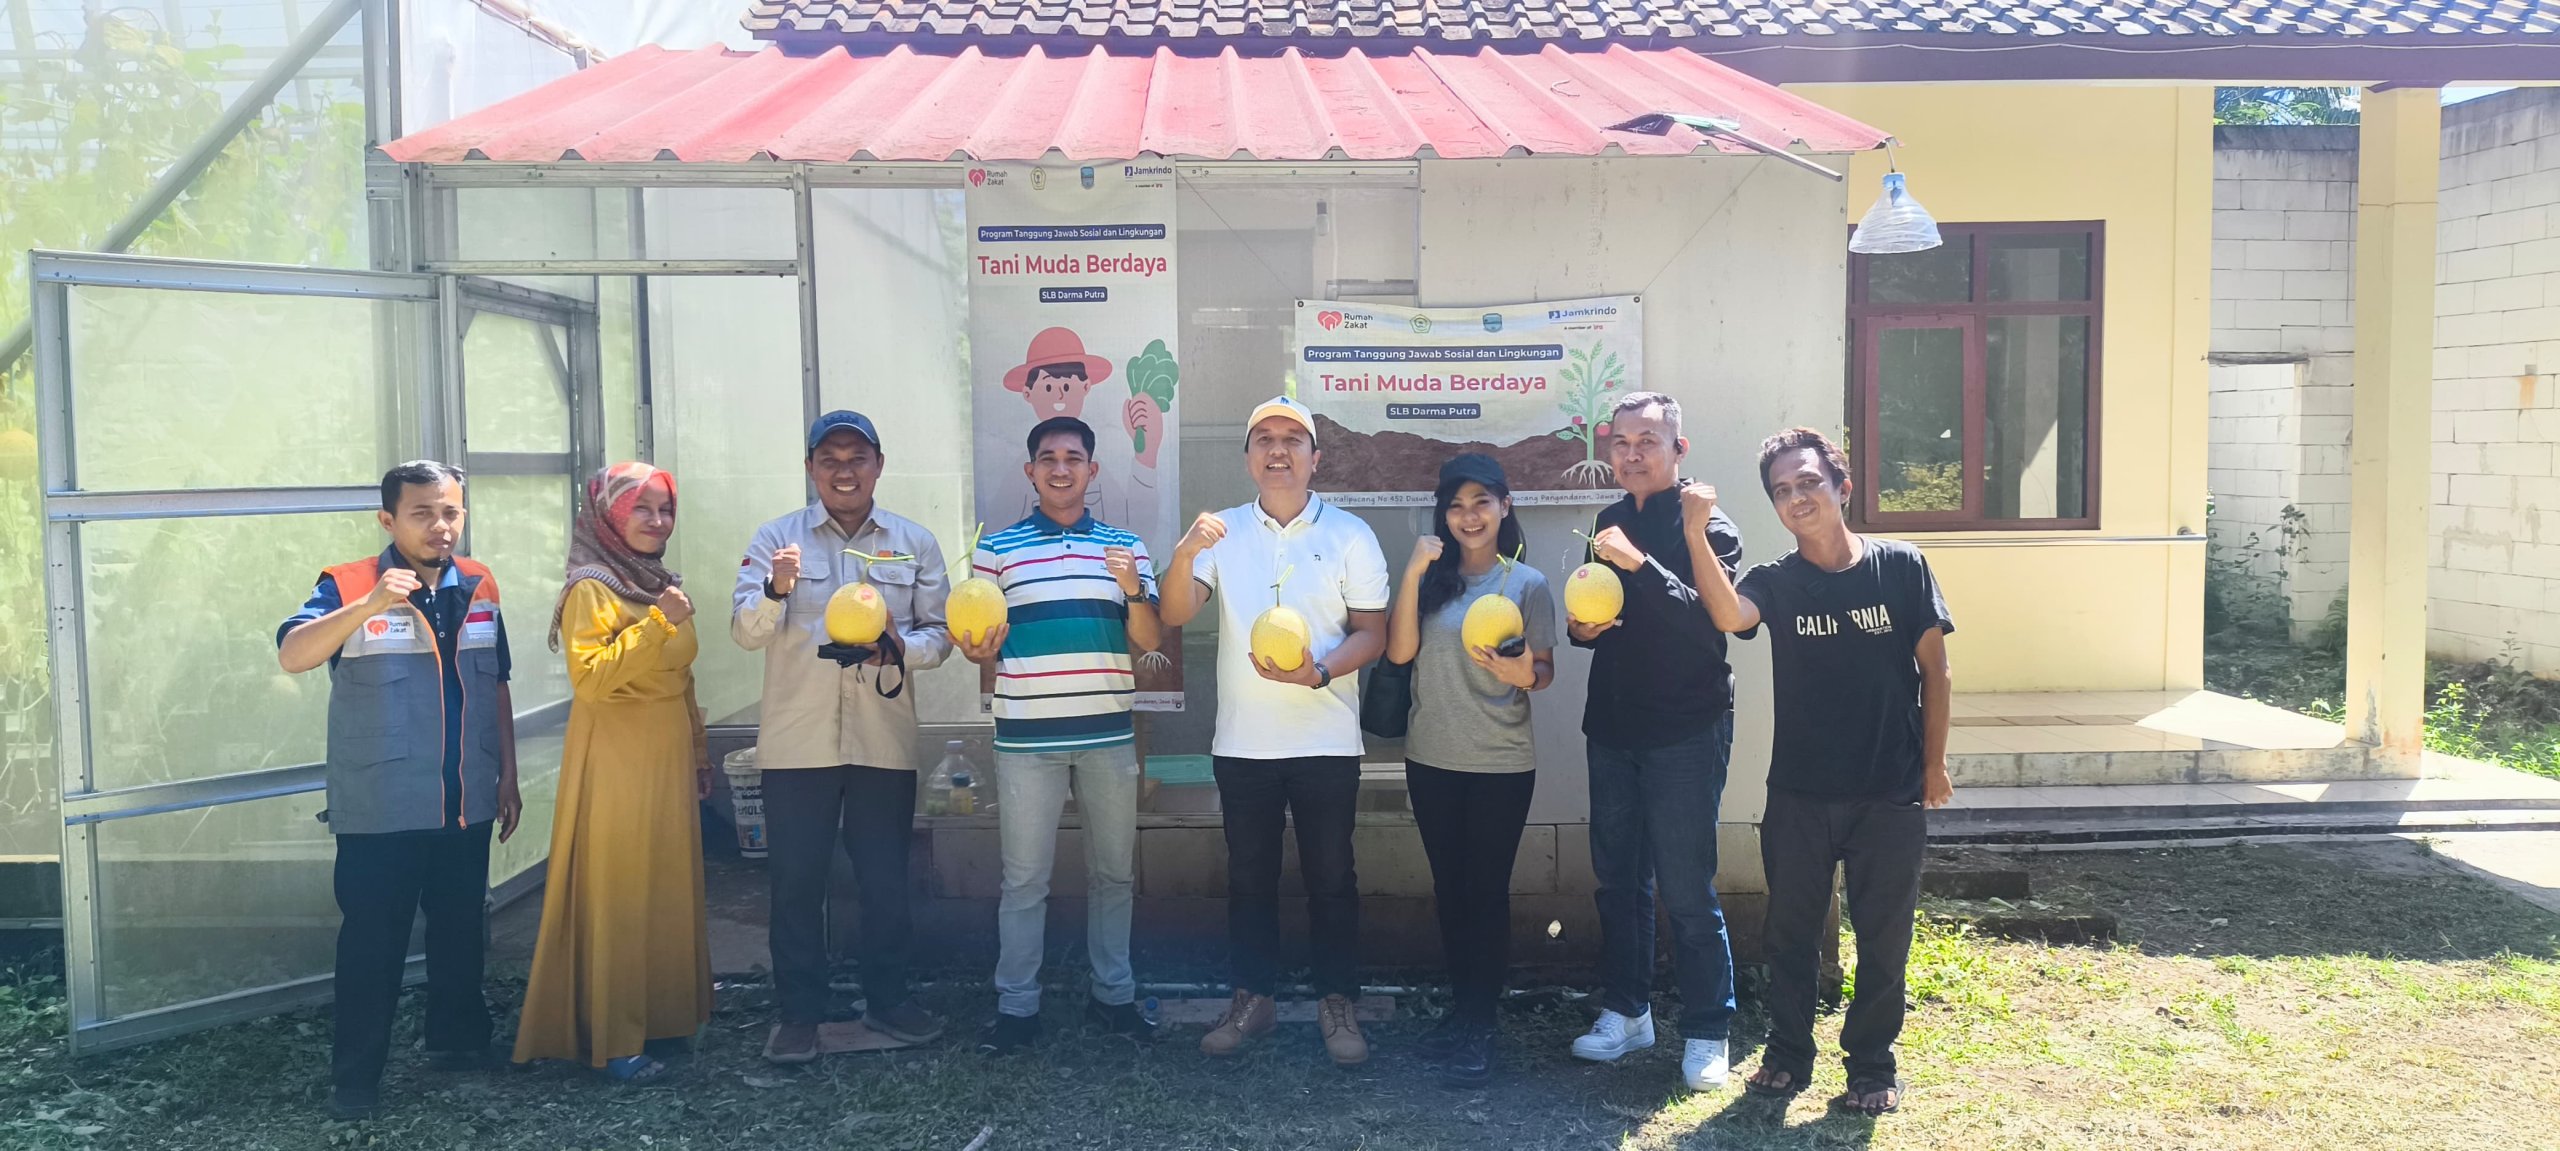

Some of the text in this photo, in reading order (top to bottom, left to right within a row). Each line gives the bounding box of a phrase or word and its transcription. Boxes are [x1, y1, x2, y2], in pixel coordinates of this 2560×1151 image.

[986, 170, 1008, 178] Rumah
[1133, 166, 1173, 176] Jamkrindo
[987, 178, 1005, 186] Zakat
[980, 227, 1163, 240] Program Tanggung Jawab Sosial dan Lingkungan
[977, 252, 1167, 277] Tani Muda Berdaya
[1041, 290, 1105, 299] SLB Darma Putra
[1561, 306, 1617, 317] Jamkrindo
[1343, 312, 1374, 321] Rumah
[1343, 321, 1368, 329] Zakat
[1307, 348, 1559, 360] Program Tanggung Jawab Sosial dan Lingkungan
[1320, 373, 1547, 394] Tani Muda Berdaya
[1390, 407, 1477, 416] SLB Darma Putra
